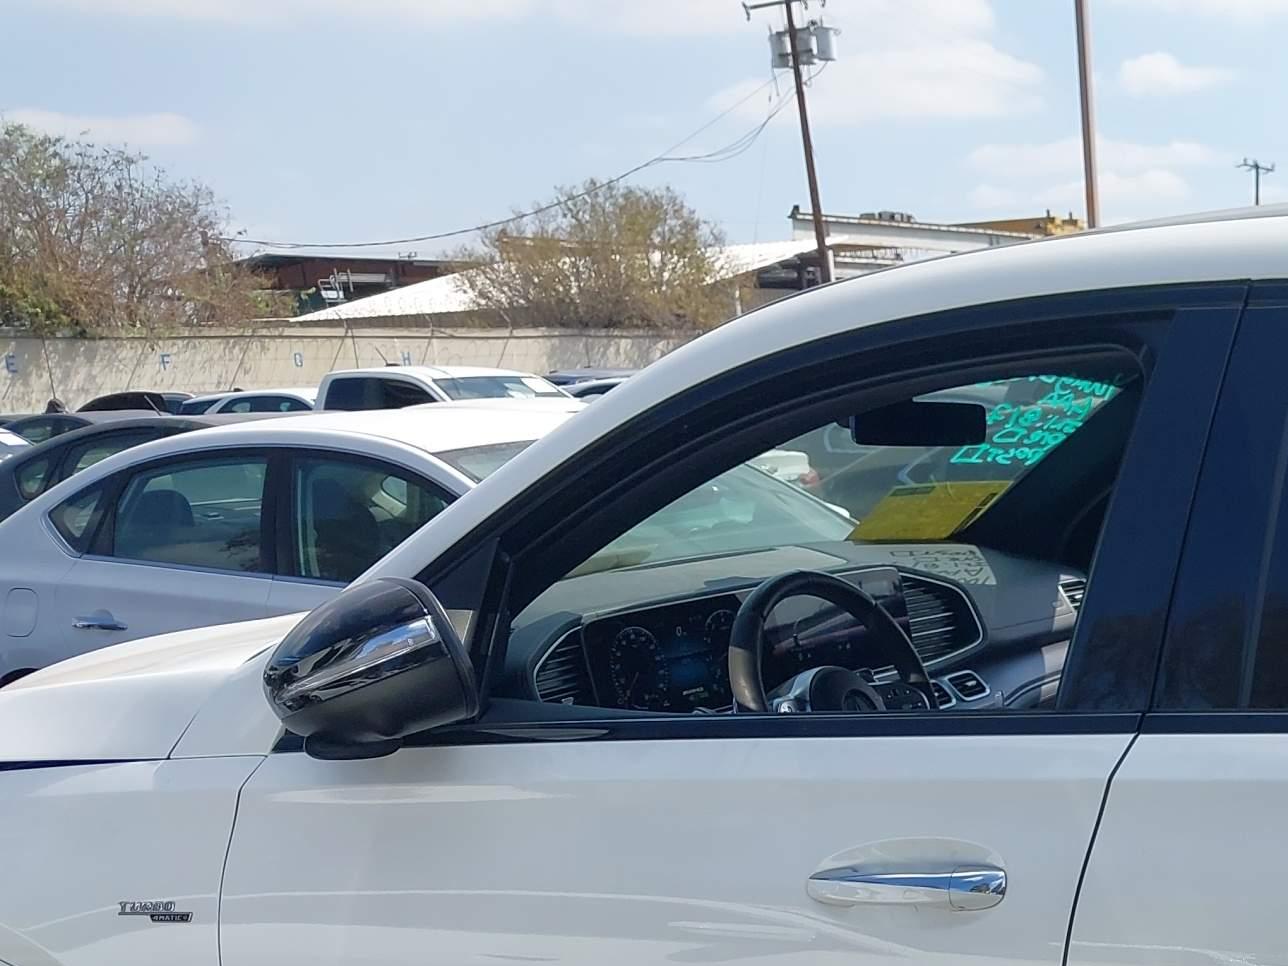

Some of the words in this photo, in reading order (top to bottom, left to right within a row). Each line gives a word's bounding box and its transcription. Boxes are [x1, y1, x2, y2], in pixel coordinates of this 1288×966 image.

[5, 354, 18, 373] E
[160, 354, 171, 371] F
[401, 351, 412, 366] H
[117, 900, 176, 912] TURBO
